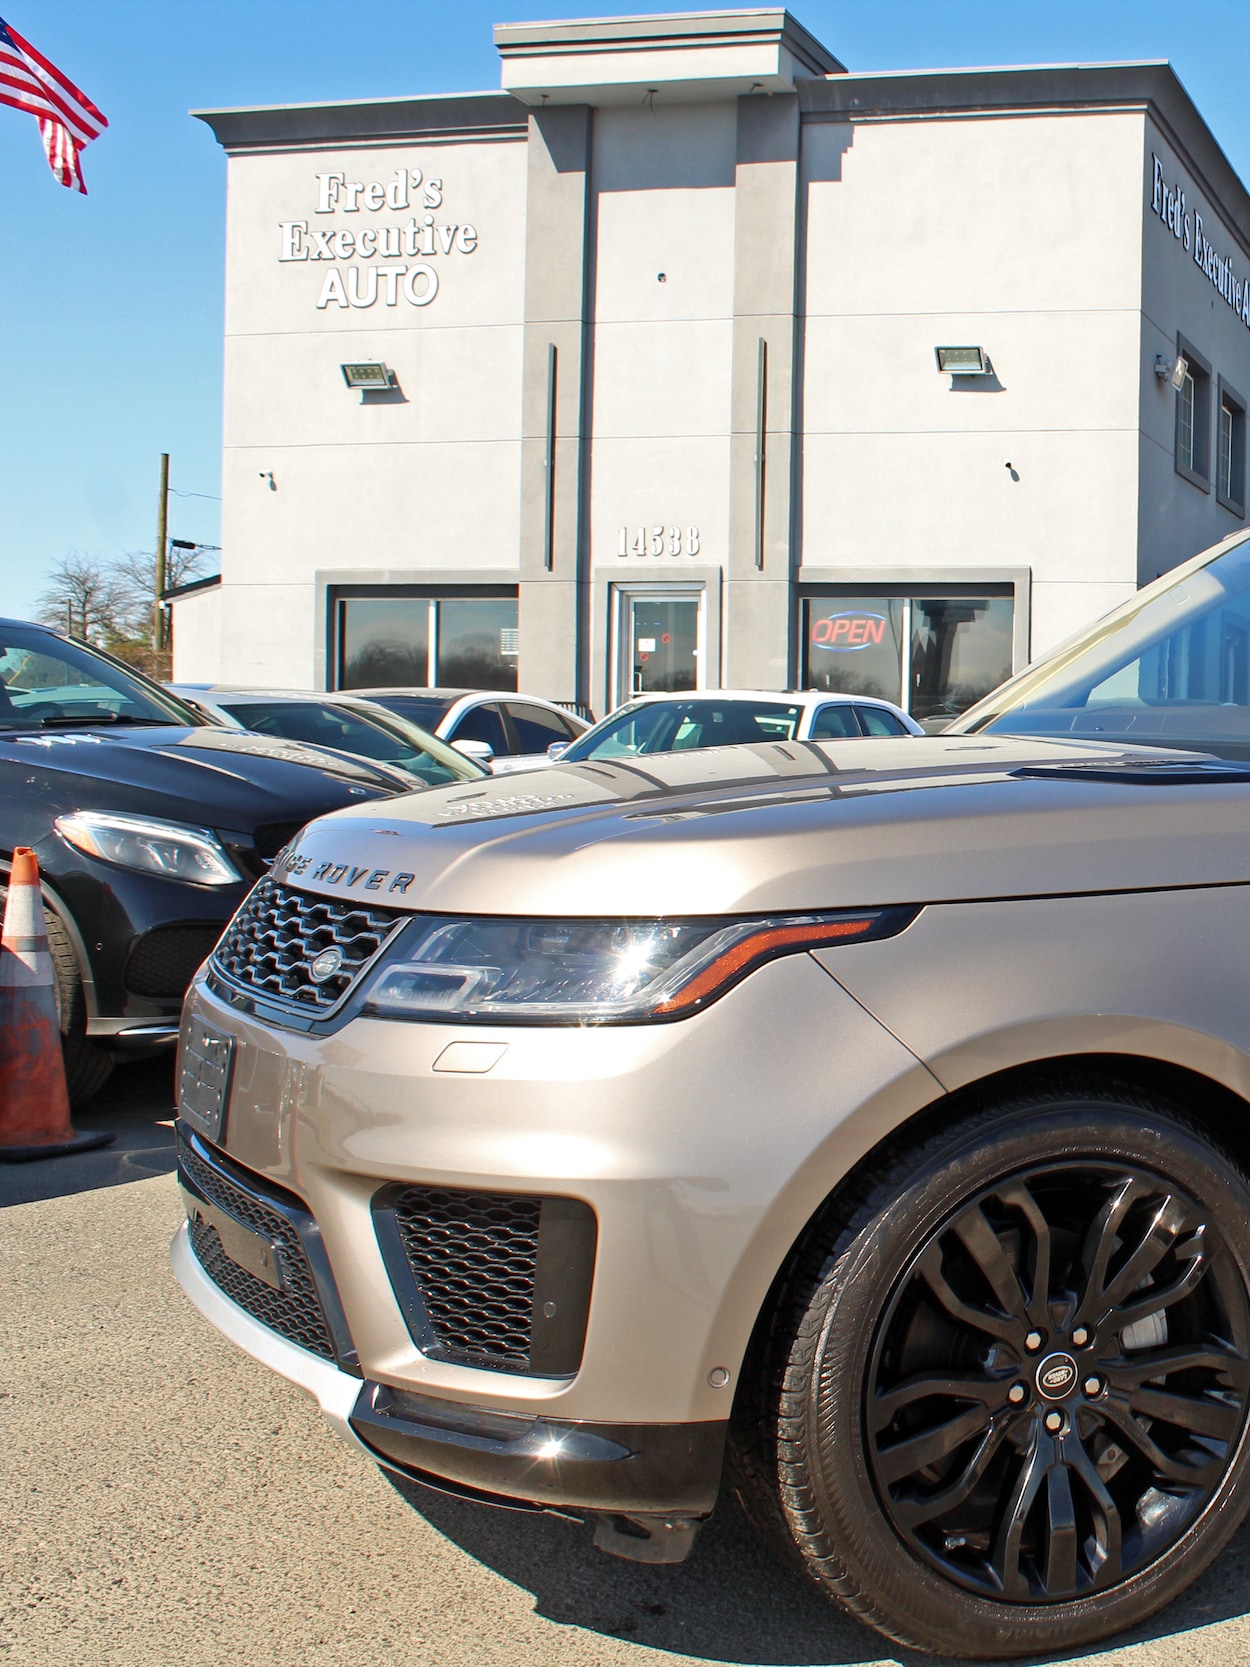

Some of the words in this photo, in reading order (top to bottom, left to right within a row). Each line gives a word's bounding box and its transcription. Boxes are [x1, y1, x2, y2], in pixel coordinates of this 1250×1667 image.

[314, 168, 443, 214] Fred's
[278, 214, 478, 262] Executive
[1151, 152, 1191, 251] Fred's
[1193, 208, 1242, 315] Executive
[315, 263, 440, 309] AUTO
[616, 525, 701, 557] 14538
[811, 618, 887, 644] OPEN
[312, 861, 416, 894] ROVER
